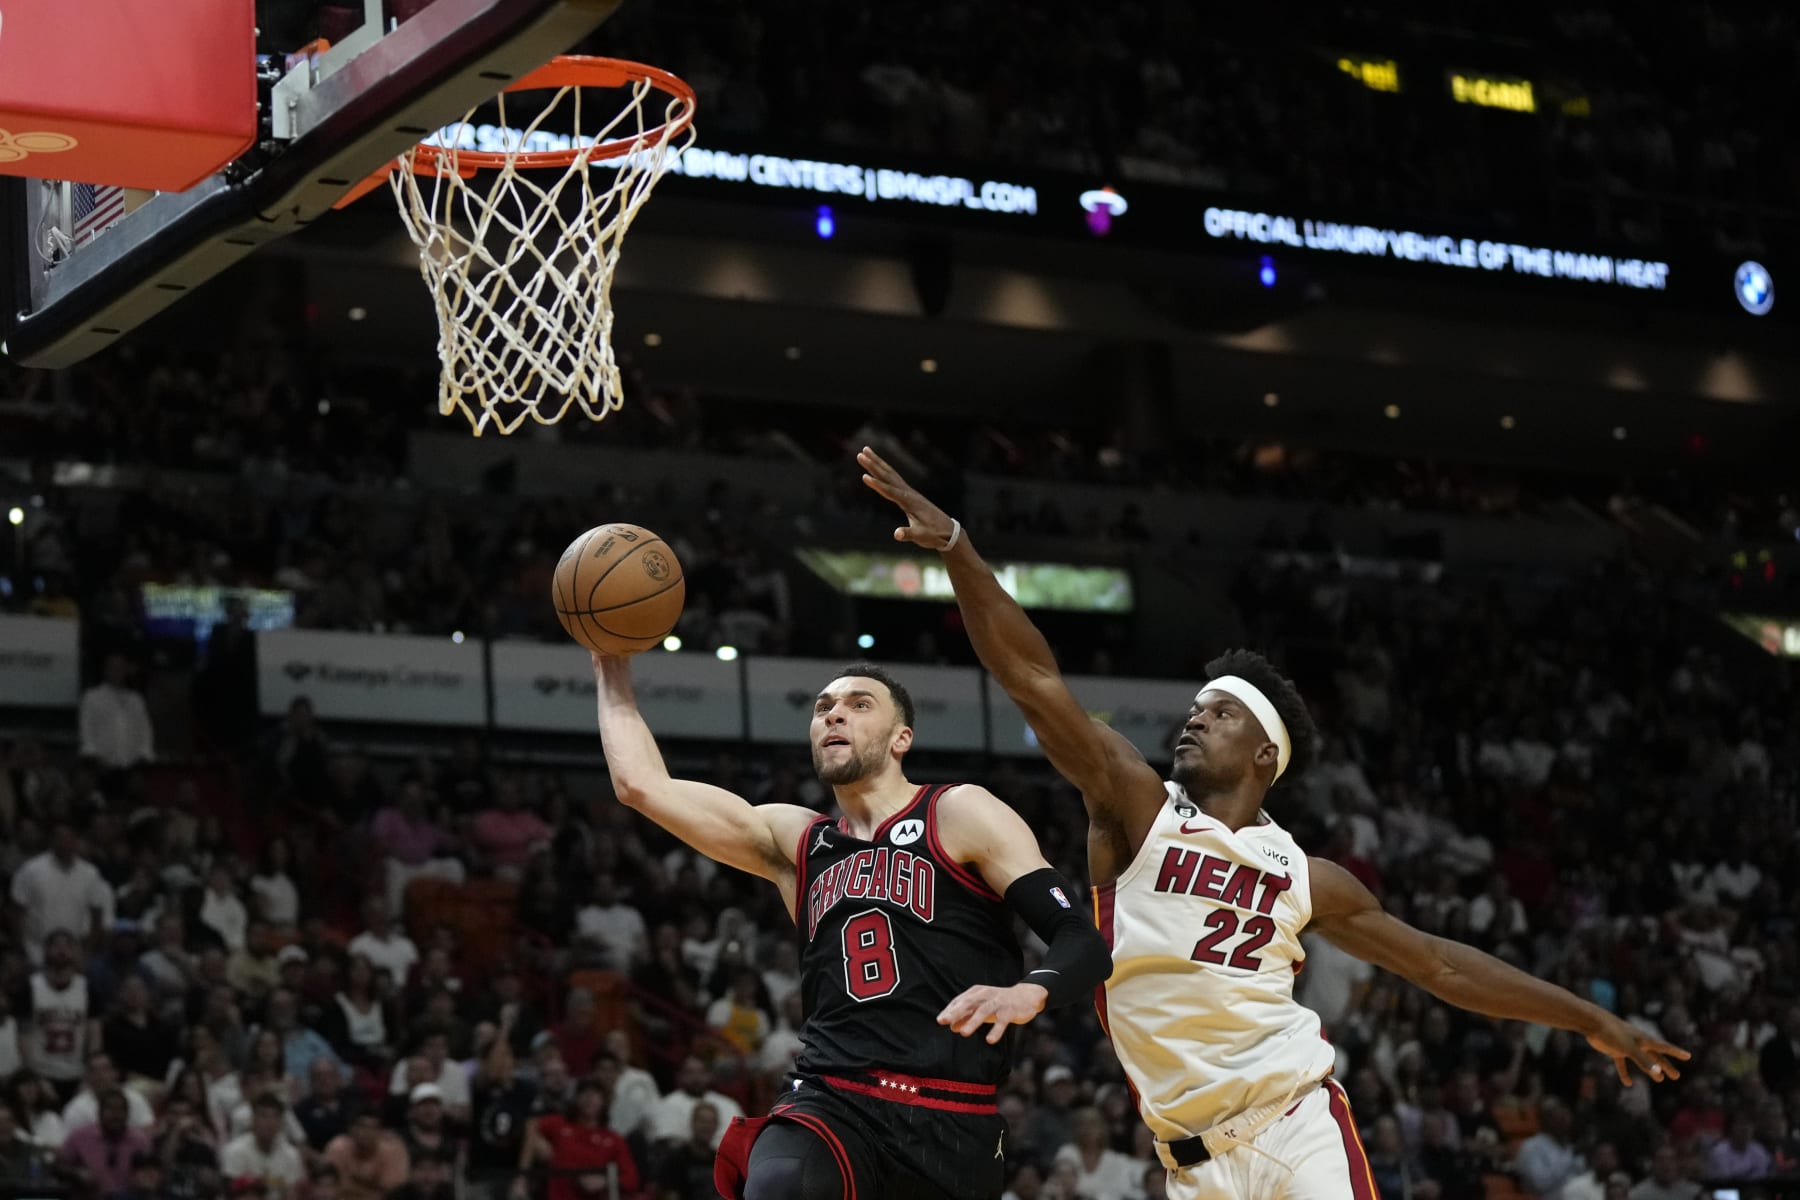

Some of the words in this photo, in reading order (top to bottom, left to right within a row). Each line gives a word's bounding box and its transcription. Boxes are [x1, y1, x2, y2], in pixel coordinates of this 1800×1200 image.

[683, 147, 749, 182] BMW
[750, 154, 865, 196] CENTERS
[1204, 207, 1304, 247] OFFICIAL
[1303, 219, 1388, 257] LUXURY
[1387, 230, 1478, 268] VEHICLE
[1478, 240, 1511, 270] OF
[1510, 244, 1553, 277] THE
[1553, 251, 1615, 283] MIAMI
[1615, 259, 1670, 290] HEAT
[1154, 846, 1293, 915] HEAT
[1262, 846, 1289, 866] UKG
[808, 847, 935, 942] CHICAGO
[842, 907, 900, 1002] 8
[1190, 908, 1276, 971] 22
